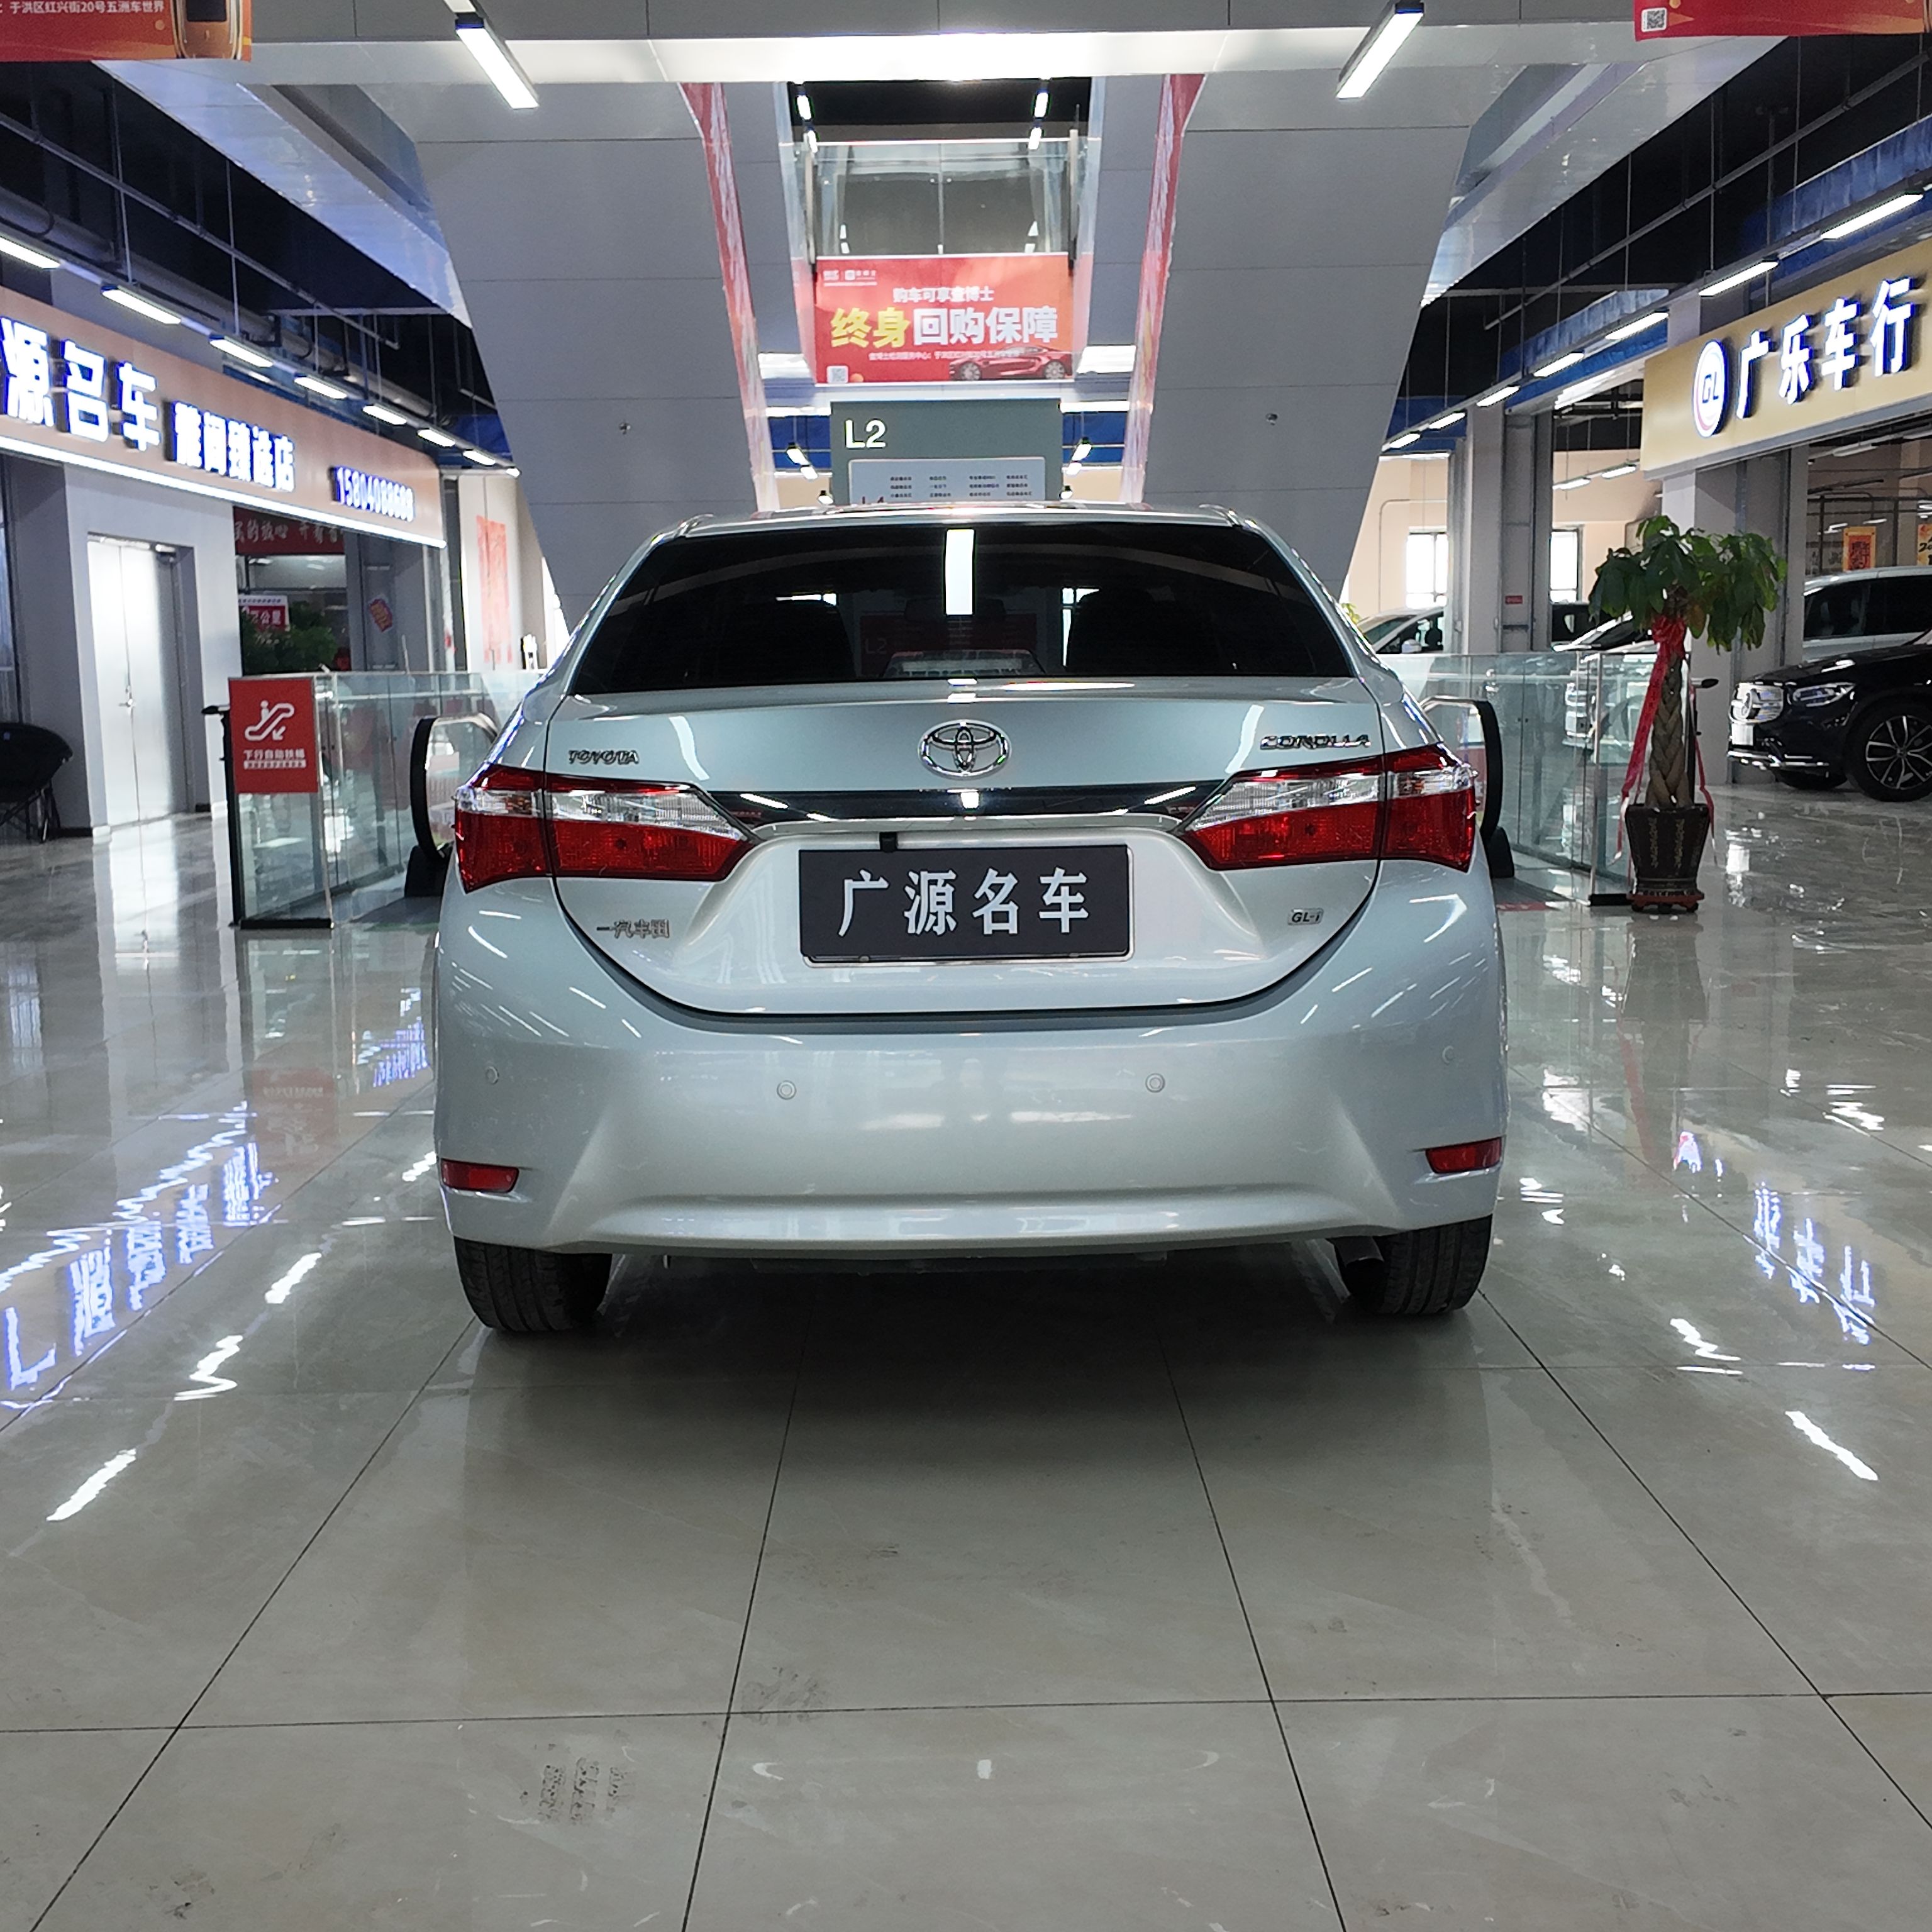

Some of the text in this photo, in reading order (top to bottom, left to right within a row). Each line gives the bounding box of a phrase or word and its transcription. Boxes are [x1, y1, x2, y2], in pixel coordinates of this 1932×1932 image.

[831, 306, 1057, 348] 终身回购保障
[1737, 276, 1914, 418] 广乐车行
[1, 318, 160, 451] 源名车
[1701, 372, 1719, 404] GL
[845, 419, 886, 448] L2
[569, 750, 639, 765] TOYOTA
[1260, 733, 1372, 750] COROLLA
[838, 867, 1089, 937] 广源名车
[596, 919, 670, 939] 一汽丰田
